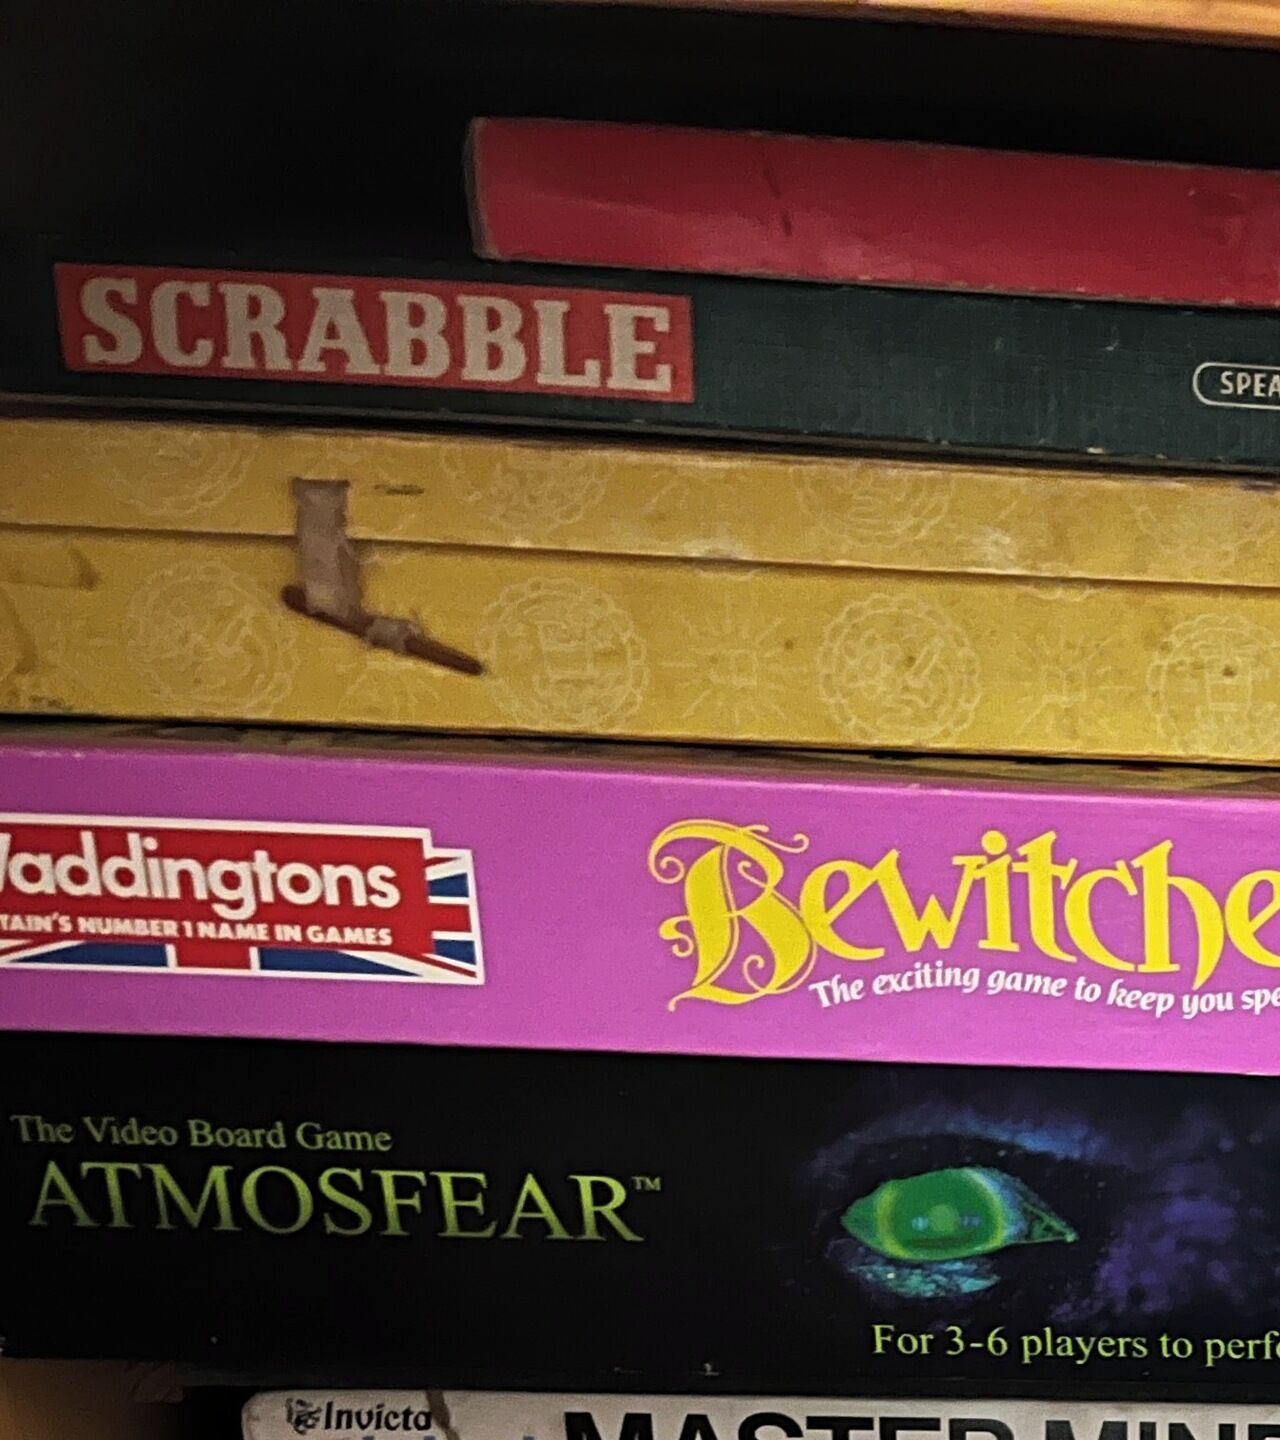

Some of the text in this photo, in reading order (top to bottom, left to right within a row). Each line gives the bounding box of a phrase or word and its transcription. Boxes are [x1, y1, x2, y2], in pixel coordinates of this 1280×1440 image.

[79, 276, 673, 395] SCRABBLE
[78, 917, 392, 946] NUMBER 1 NAME IN GAMES
[809, 977, 864, 1009] The
[872, 963, 980, 1001] exciting
[986, 969, 1068, 1000] game
[1073, 977, 1101, 1003] to
[1107, 979, 1175, 1018] keep
[1182, 990, 1233, 1020] you
[12, 1114, 392, 1153] The Video Board Game
[872, 1324, 933, 1358] For
[944, 1325, 1007, 1358] 3-6
[1022, 1326, 1147, 1366] players
[1159, 1332, 1193, 1361] to
[325, 1402, 432, 1431] Invicta
